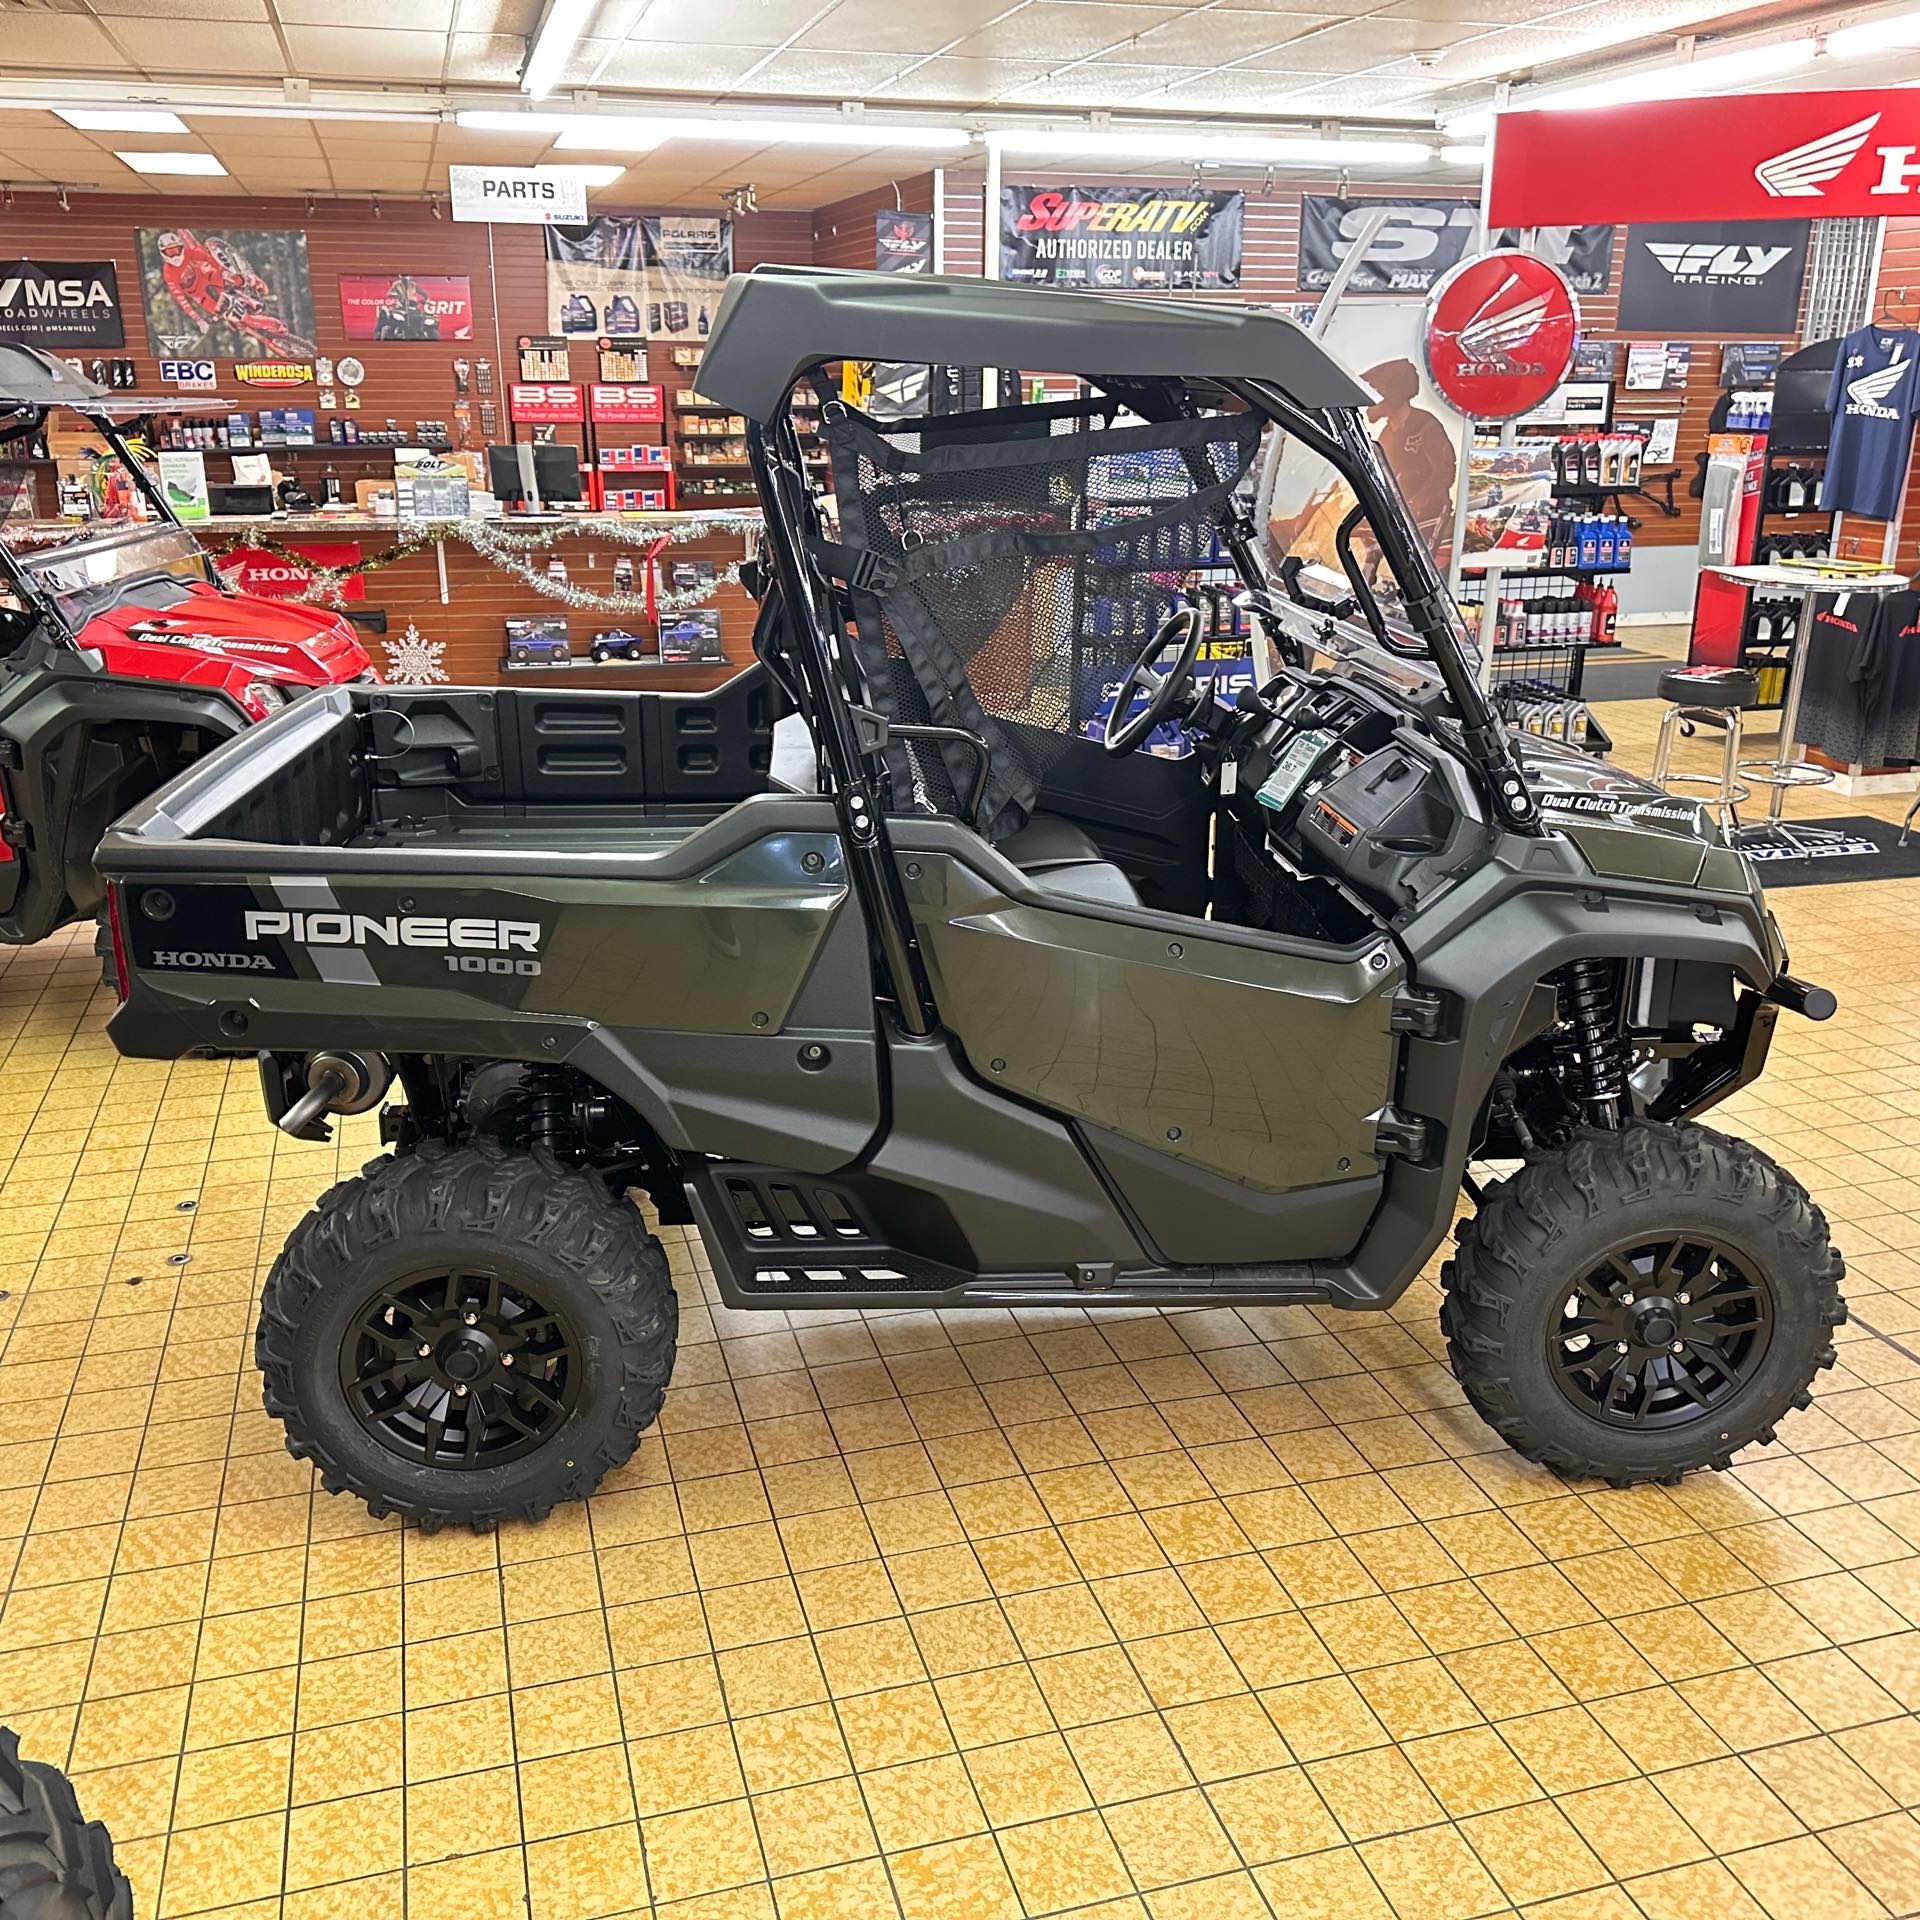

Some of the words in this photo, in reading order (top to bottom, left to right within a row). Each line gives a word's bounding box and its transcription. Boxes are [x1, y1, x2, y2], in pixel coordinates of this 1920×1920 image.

[482, 180, 555, 199] PARTS
[1036, 238, 1132, 259] AUTHORIZED
[1136, 240, 1193, 261] DEALER
[1645, 242, 1793, 276] FLY
[1388, 273, 1434, 289] MAX
[1673, 274, 1756, 286] RACING
[25, 279, 113, 307] MSA
[347, 298, 360, 306] THE
[361, 298, 384, 306] COLOR
[423, 301, 466, 315] GRIT
[161, 362, 213, 381] EBC
[235, 364, 314, 381] WINDEROSA
[1456, 362, 1545, 377] HONDA
[178, 381, 215, 390] BRAKES
[513, 386, 578, 404] BS
[593, 387, 657, 404] BS
[1845, 404, 1900, 420] HONDA
[415, 460, 445, 469] BOLT
[1824, 615, 1858, 632] HONDA
[137, 633, 167, 643] Dual
[169, 635, 209, 647] Clutch
[211, 638, 290, 654] Transmission
[1541, 793, 1572, 809] Dual
[1574, 796, 1616, 813] Clutch
[1617, 801, 1696, 822] Transmission
[244, 910, 541, 953] PIONEER
[152, 951, 276, 970] HONDA
[443, 955, 542, 976] 1000
